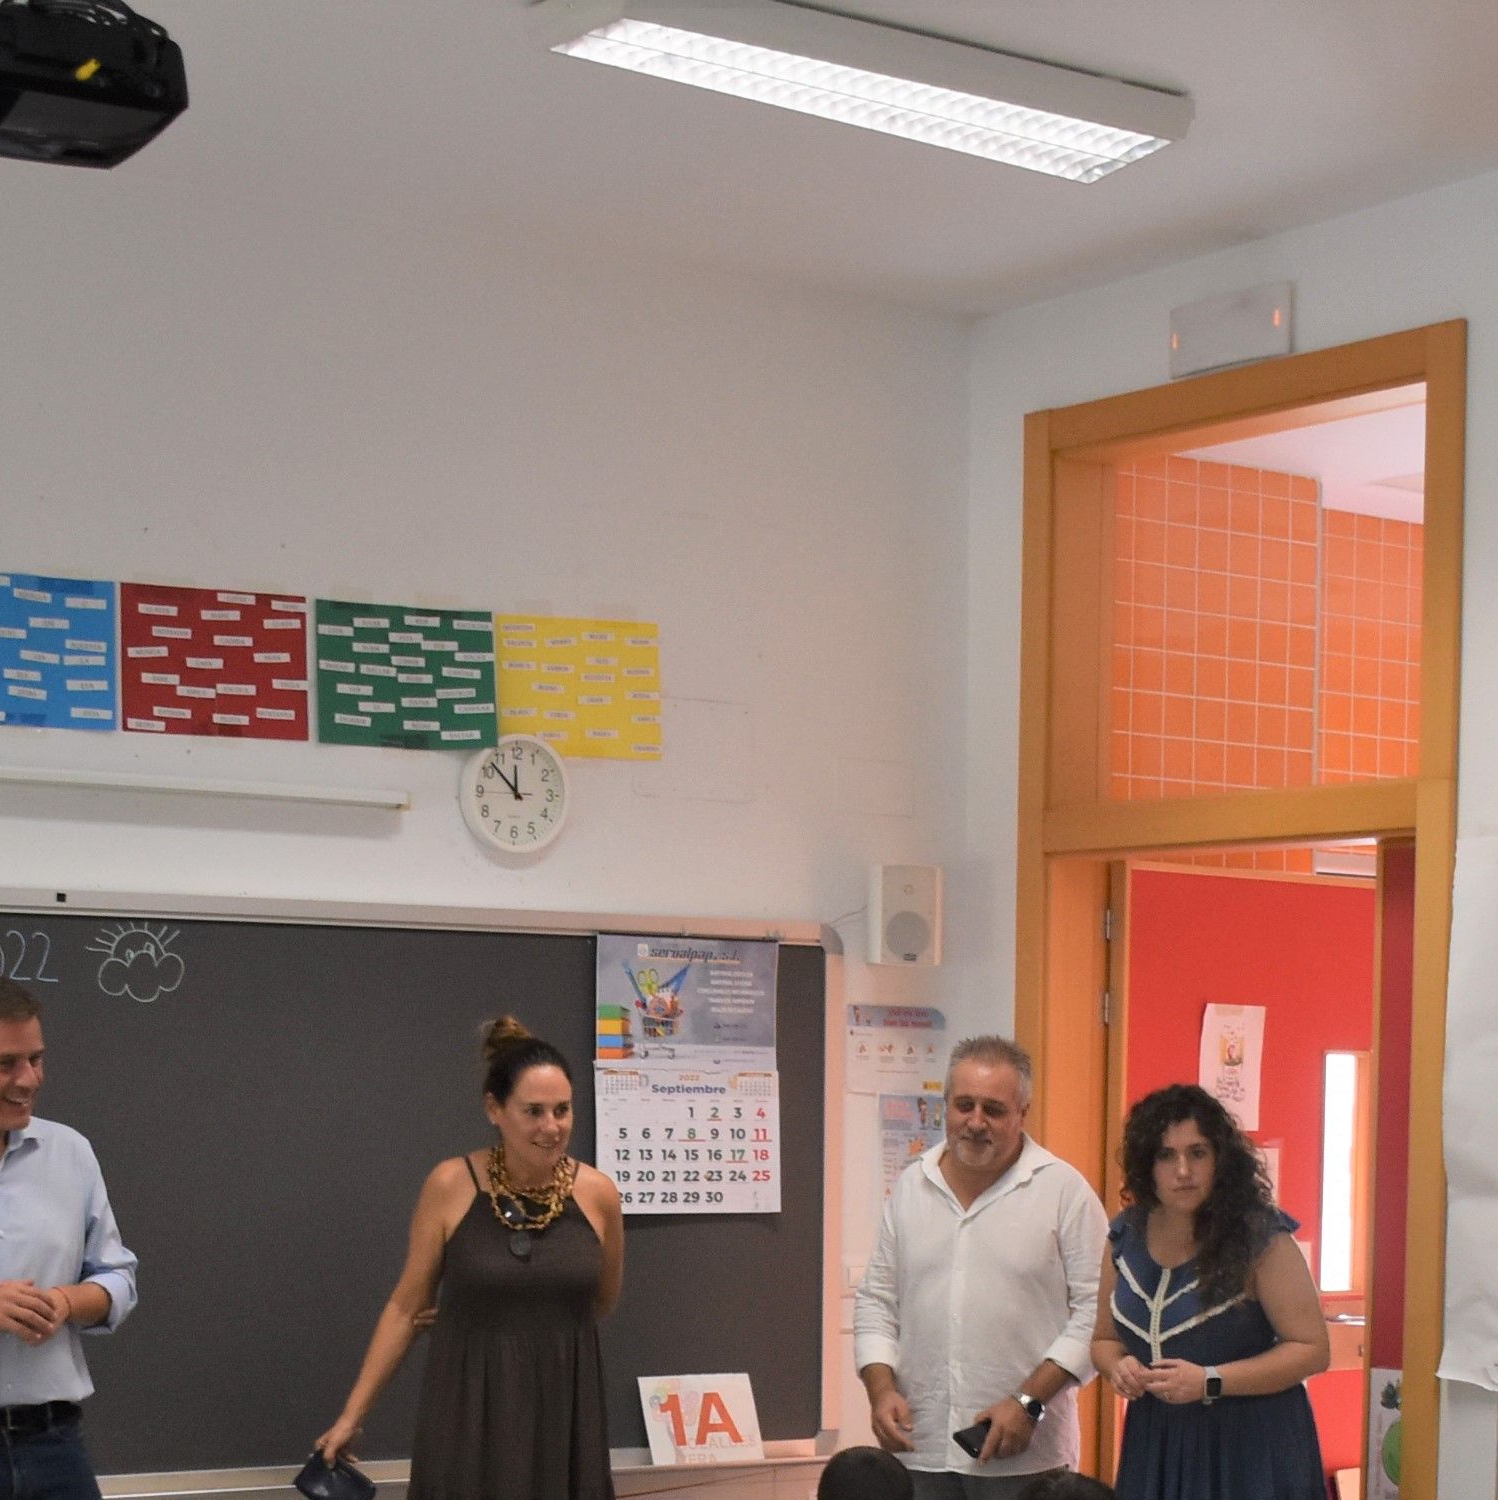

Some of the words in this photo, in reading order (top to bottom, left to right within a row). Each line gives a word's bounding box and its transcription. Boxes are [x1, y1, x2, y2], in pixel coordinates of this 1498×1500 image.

[495, 753, 506, 765] 11
[512, 746, 523, 760] 12
[530, 753, 536, 765] 1
[541, 769, 550, 783] 2
[476, 785, 485, 798] 9
[546, 789, 554, 803] 3
[481, 804, 490, 818] 8
[540, 807, 549, 820] 4
[493, 819, 502, 833] 7
[510, 825, 519, 839] 6
[527, 821, 536, 835] 5
[651, 1083, 726, 1096] Septiembre
[688, 1106, 694, 1119] 1
[710, 1106, 719, 1119] 2
[733, 1107, 743, 1119] 3
[756, 1108, 766, 1119] 4
[618, 1127, 628, 1140] 5
[641, 1127, 651, 1140] 6
[664, 1127, 674, 1140] 7
[687, 1127, 696, 1139] 8
[710, 1127, 720, 1140] 9
[729, 1128, 746, 1140] 10
[754, 1128, 767, 1140] 11
[615, 1148, 631, 1161] 12
[638, 1148, 654, 1161] 13
[661, 1149, 677, 1161] 14
[684, 1149, 699, 1161] 15
[707, 1149, 723, 1161] 16
[730, 1149, 745, 1161] 17
[753, 1149, 769, 1161] 18
[615, 1170, 631, 1182] 19
[636, 1170, 656, 1182] 20
[661, 1170, 676, 1182] 21
[683, 1170, 700, 1182] 22
[706, 1170, 723, 1182] 23
[729, 1170, 747, 1182] 24
[752, 1170, 771, 1182] 25
[637, 1191, 656, 1203] 27
[660, 1191, 679, 1203] 28
[682, 1191, 701, 1203] 29
[705, 1191, 724, 1203] 30
[659, 1391, 744, 1447] 1A
